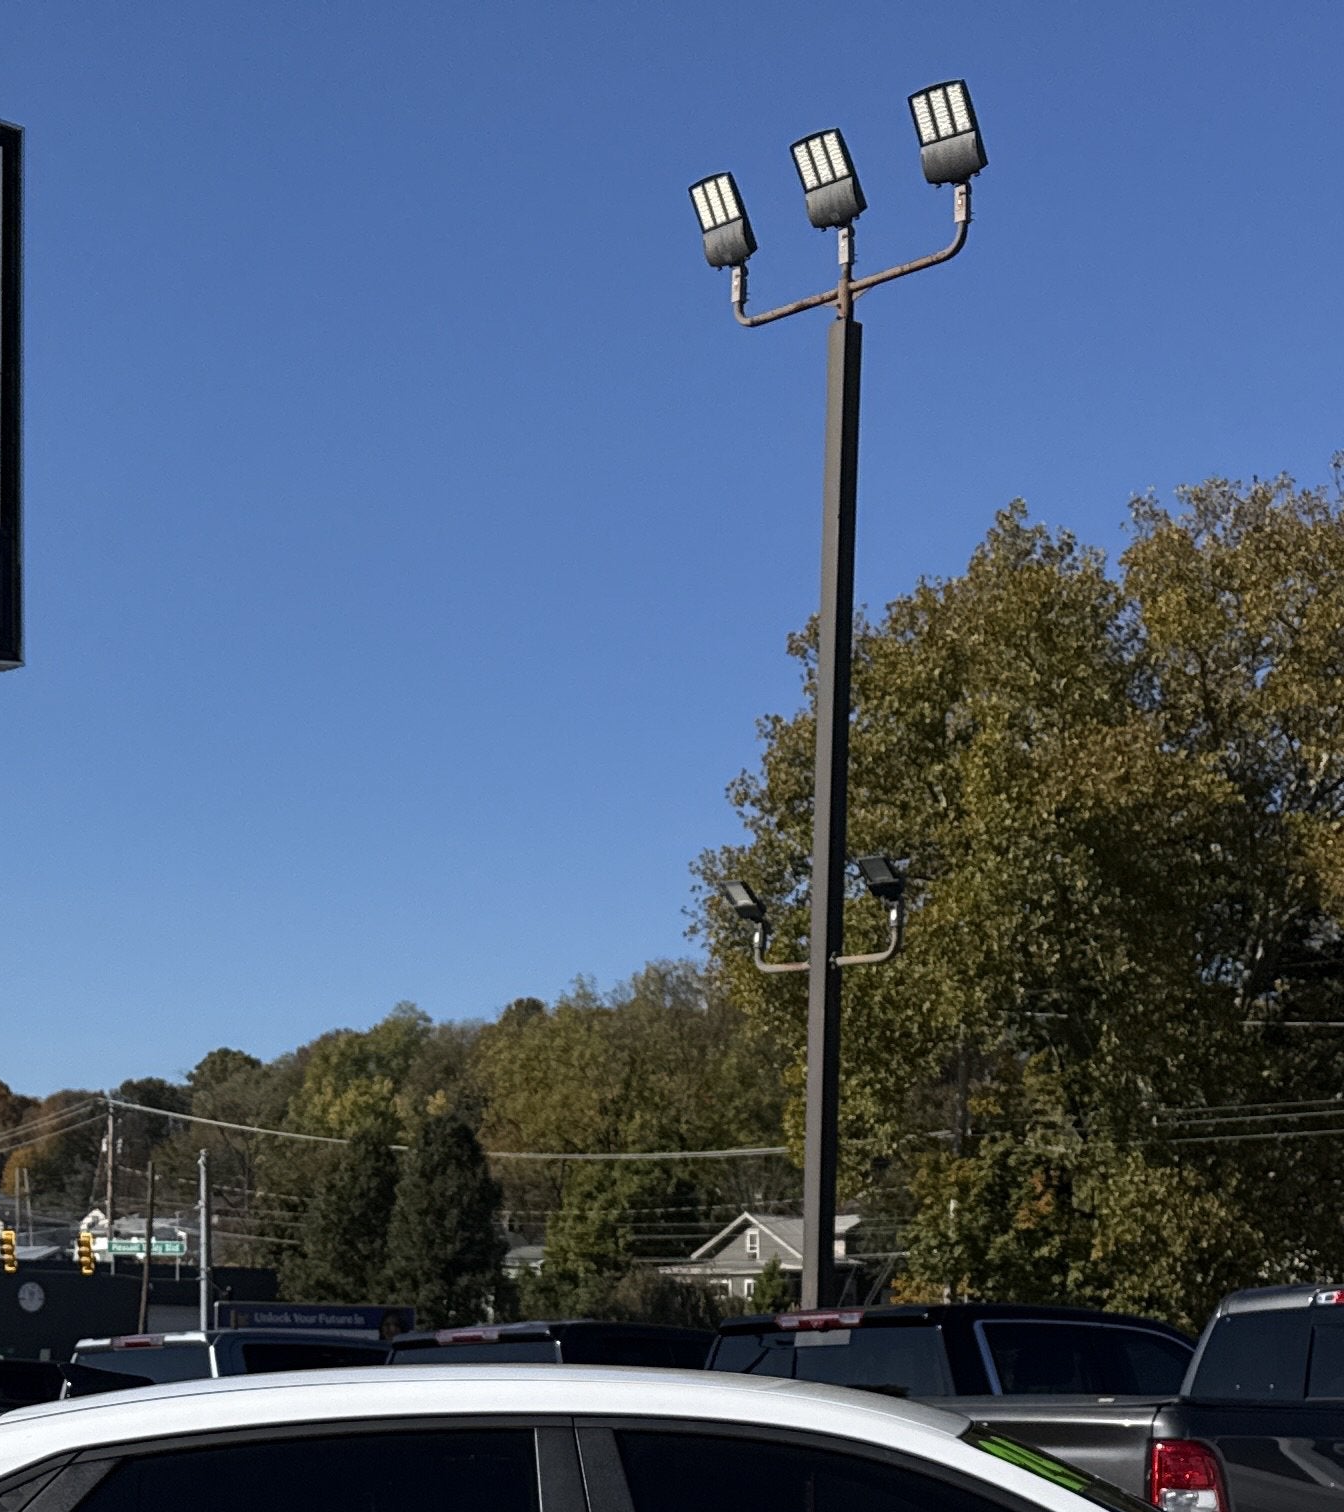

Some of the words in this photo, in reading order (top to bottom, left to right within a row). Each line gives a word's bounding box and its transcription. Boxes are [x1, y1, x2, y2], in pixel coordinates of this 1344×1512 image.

[254, 1312, 289, 1323] Unlock
[294, 1312, 316, 1323] Your
[318, 1313, 353, 1324] Future
